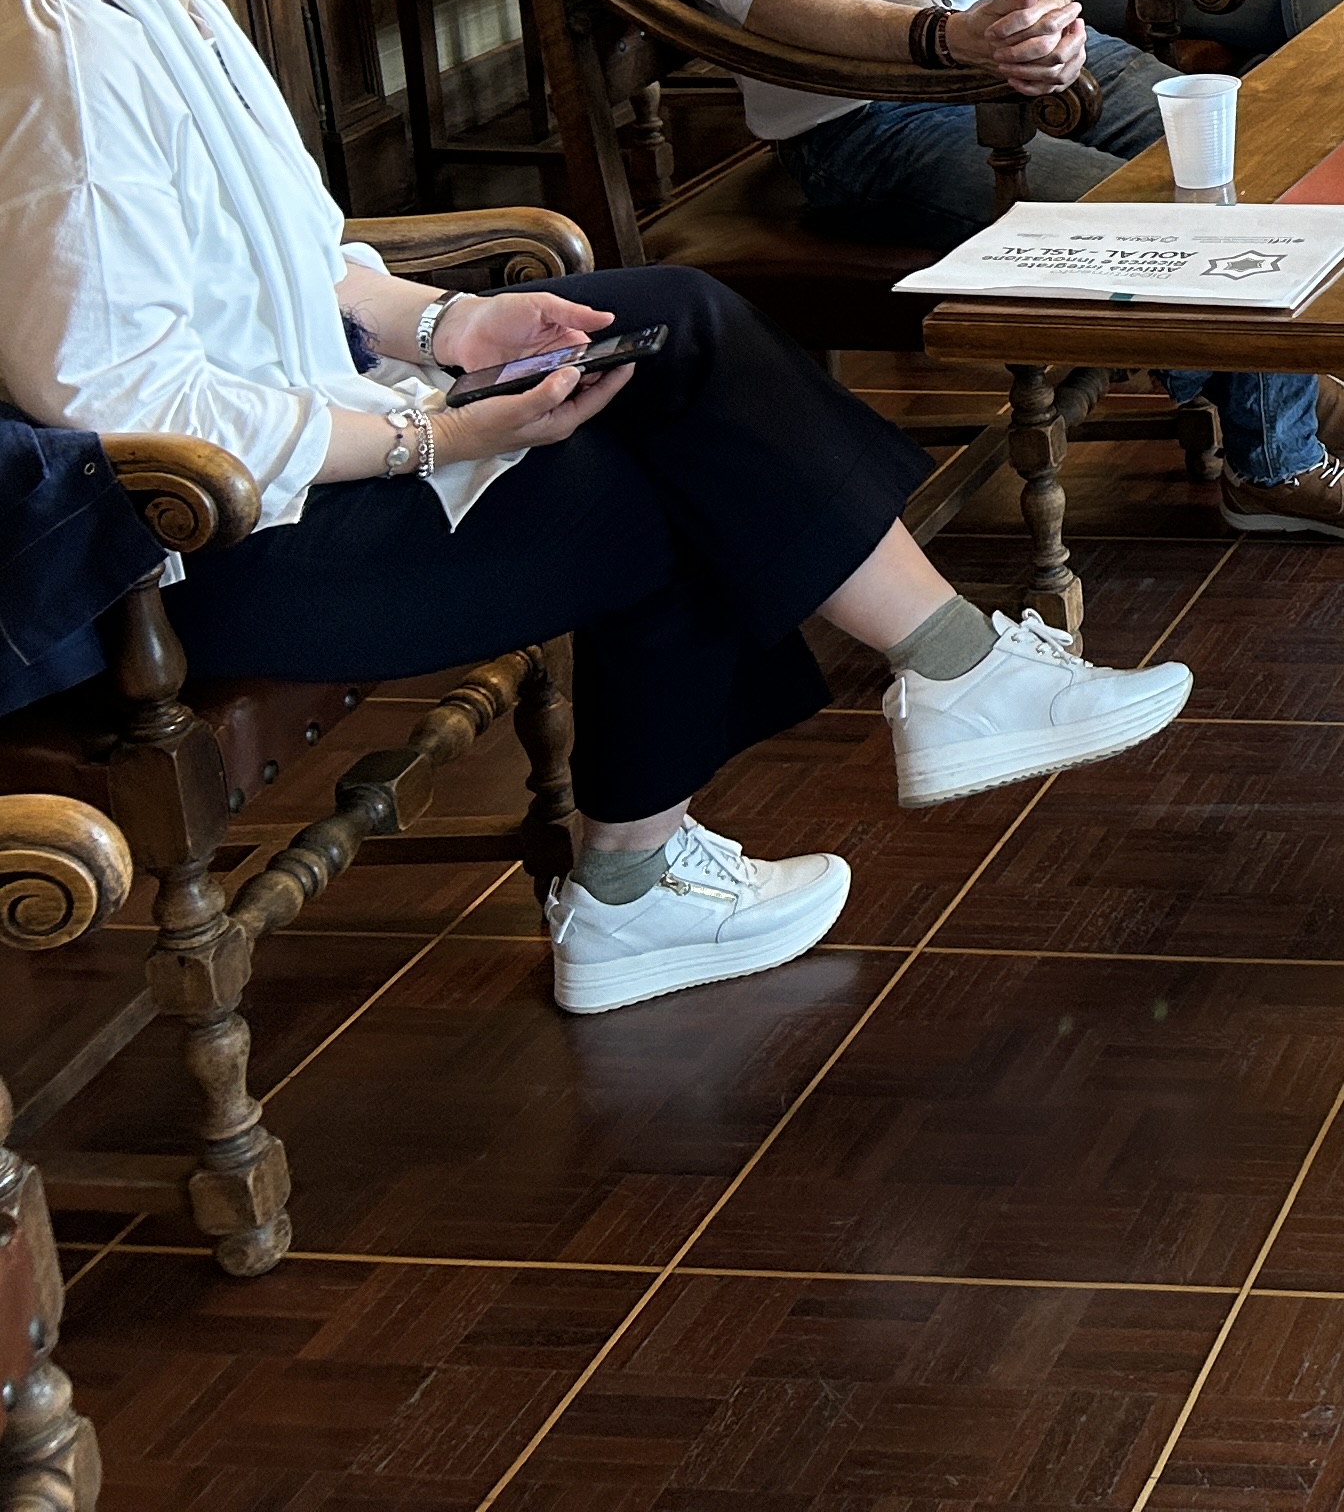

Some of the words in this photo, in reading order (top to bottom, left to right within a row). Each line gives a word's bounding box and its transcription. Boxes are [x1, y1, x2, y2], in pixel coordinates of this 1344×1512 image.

[1002, 246, 1035, 255] AL
[1040, 247, 1087, 256] ASL
[1105, 249, 1139, 259] AL
[1139, 251, 1199, 259] AOU
[981, 255, 1096, 265] innovazione
[1117, 258, 1189, 267] Ricerca
[1016, 262, 1104, 271] integrate
[1109, 265, 1182, 273] Attività
